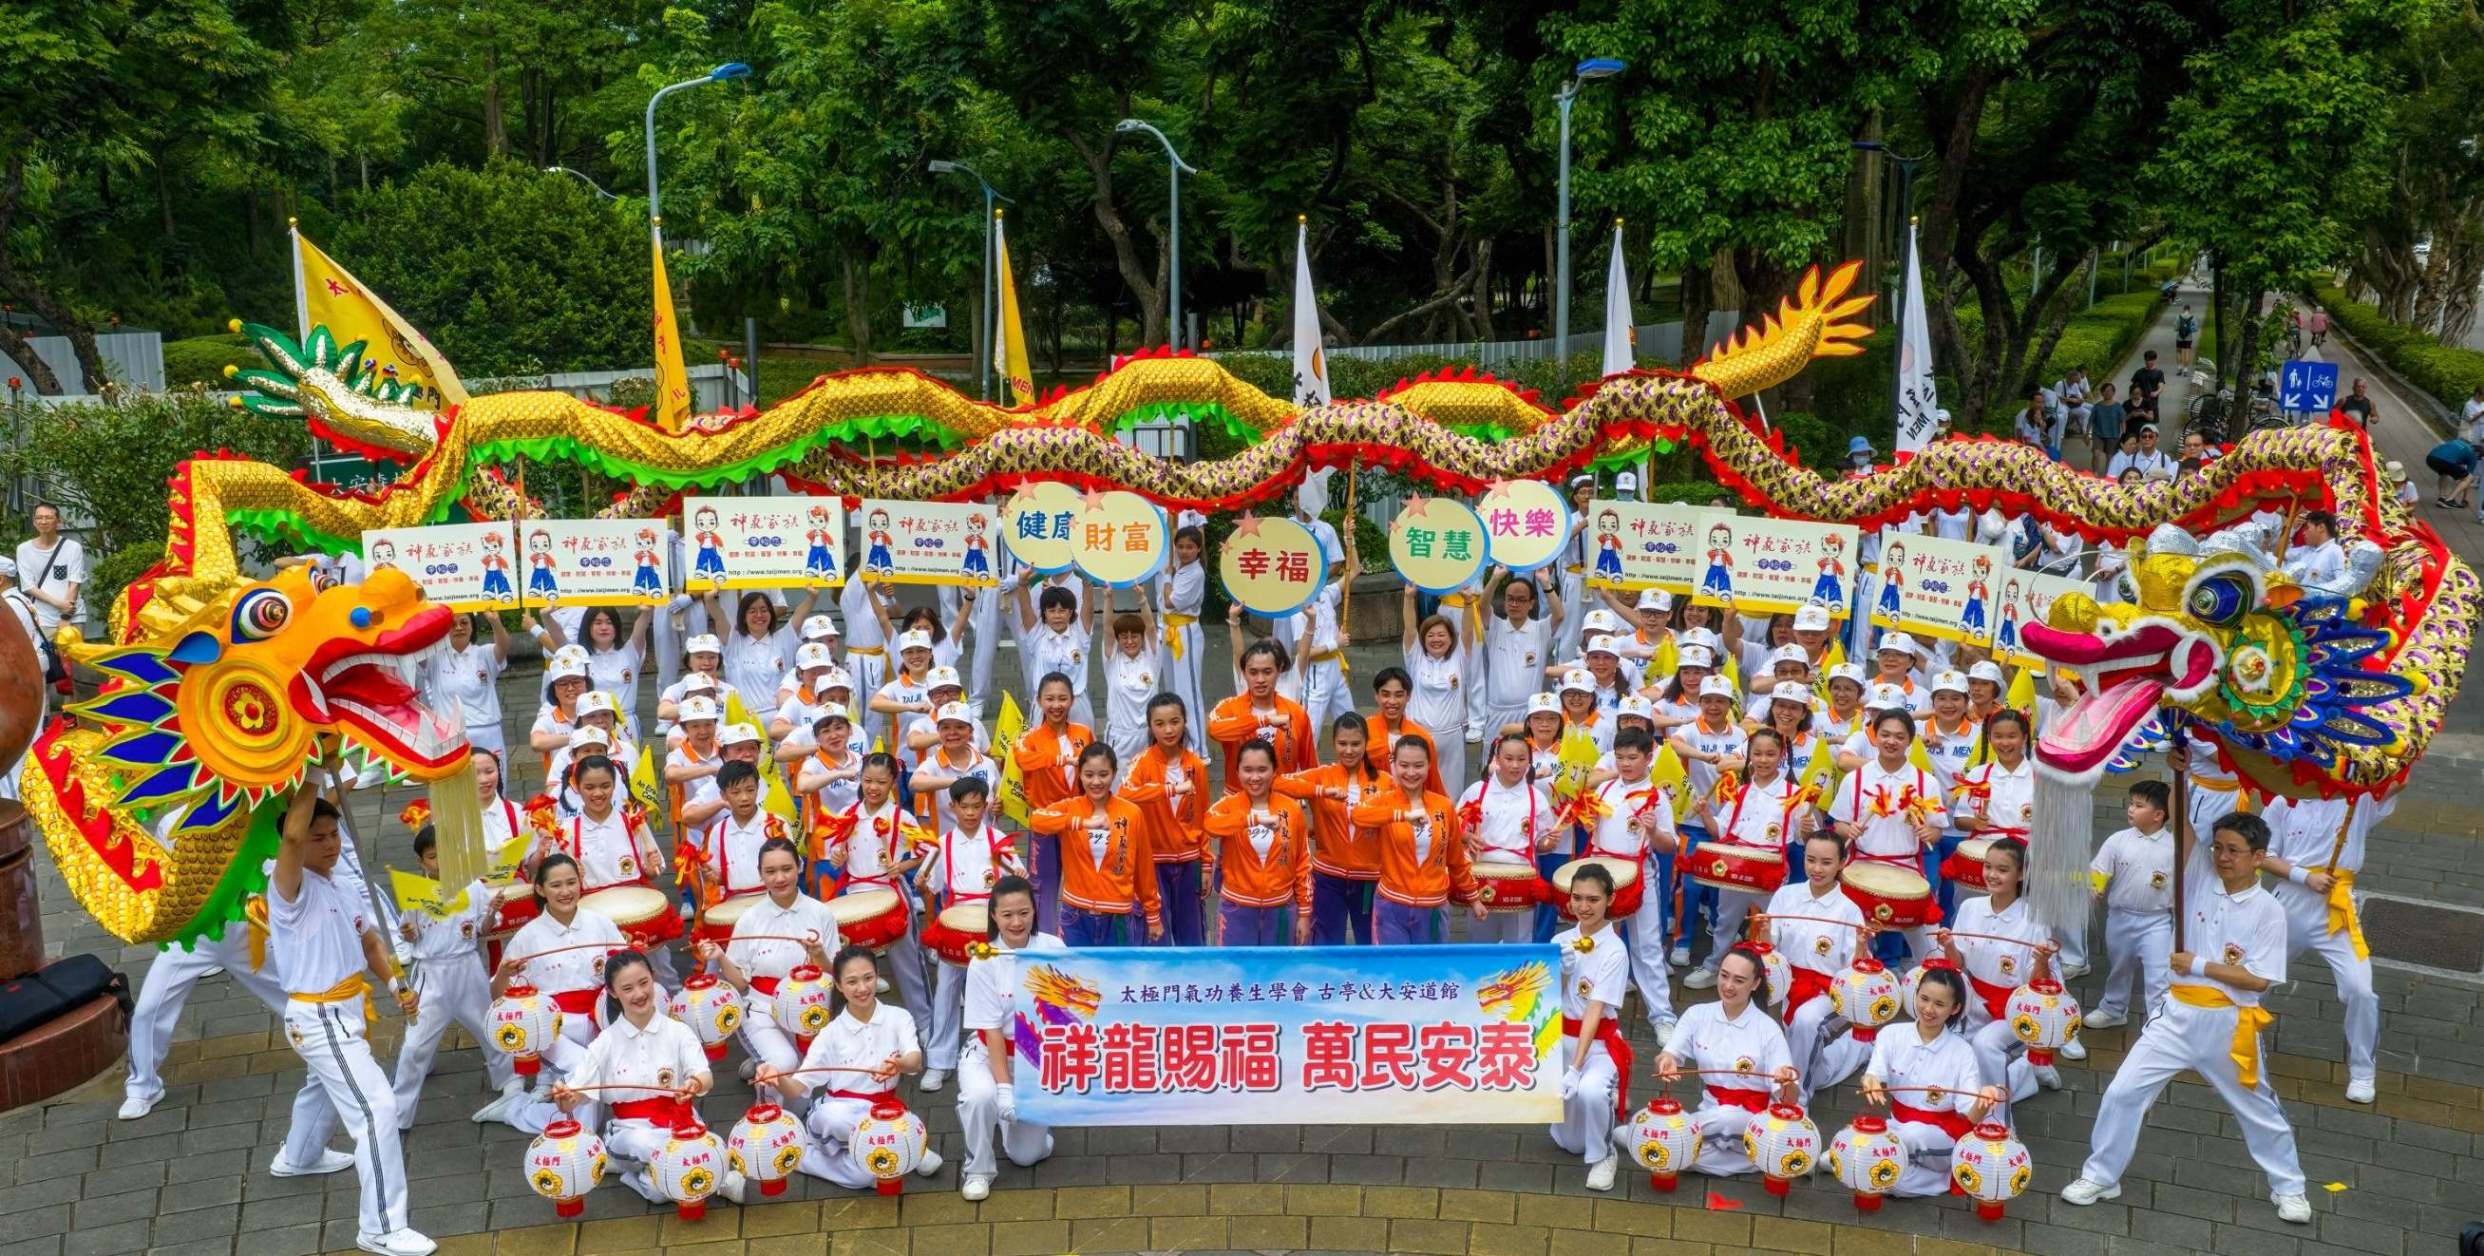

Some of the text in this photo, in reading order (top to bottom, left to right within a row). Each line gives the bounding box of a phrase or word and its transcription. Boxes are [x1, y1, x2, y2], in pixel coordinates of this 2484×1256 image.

[1084, 522, 1151, 552] 財富
[1489, 508, 1555, 537] 快樂
[1406, 526, 1472, 561] 智慧
[1238, 547, 1309, 583] 幸福
[1120, 981, 1459, 1004] 太極門氣功養生學會 古亭&大安道館
[1039, 1019, 1541, 1094] 祥龍賜福 萬民安泰
